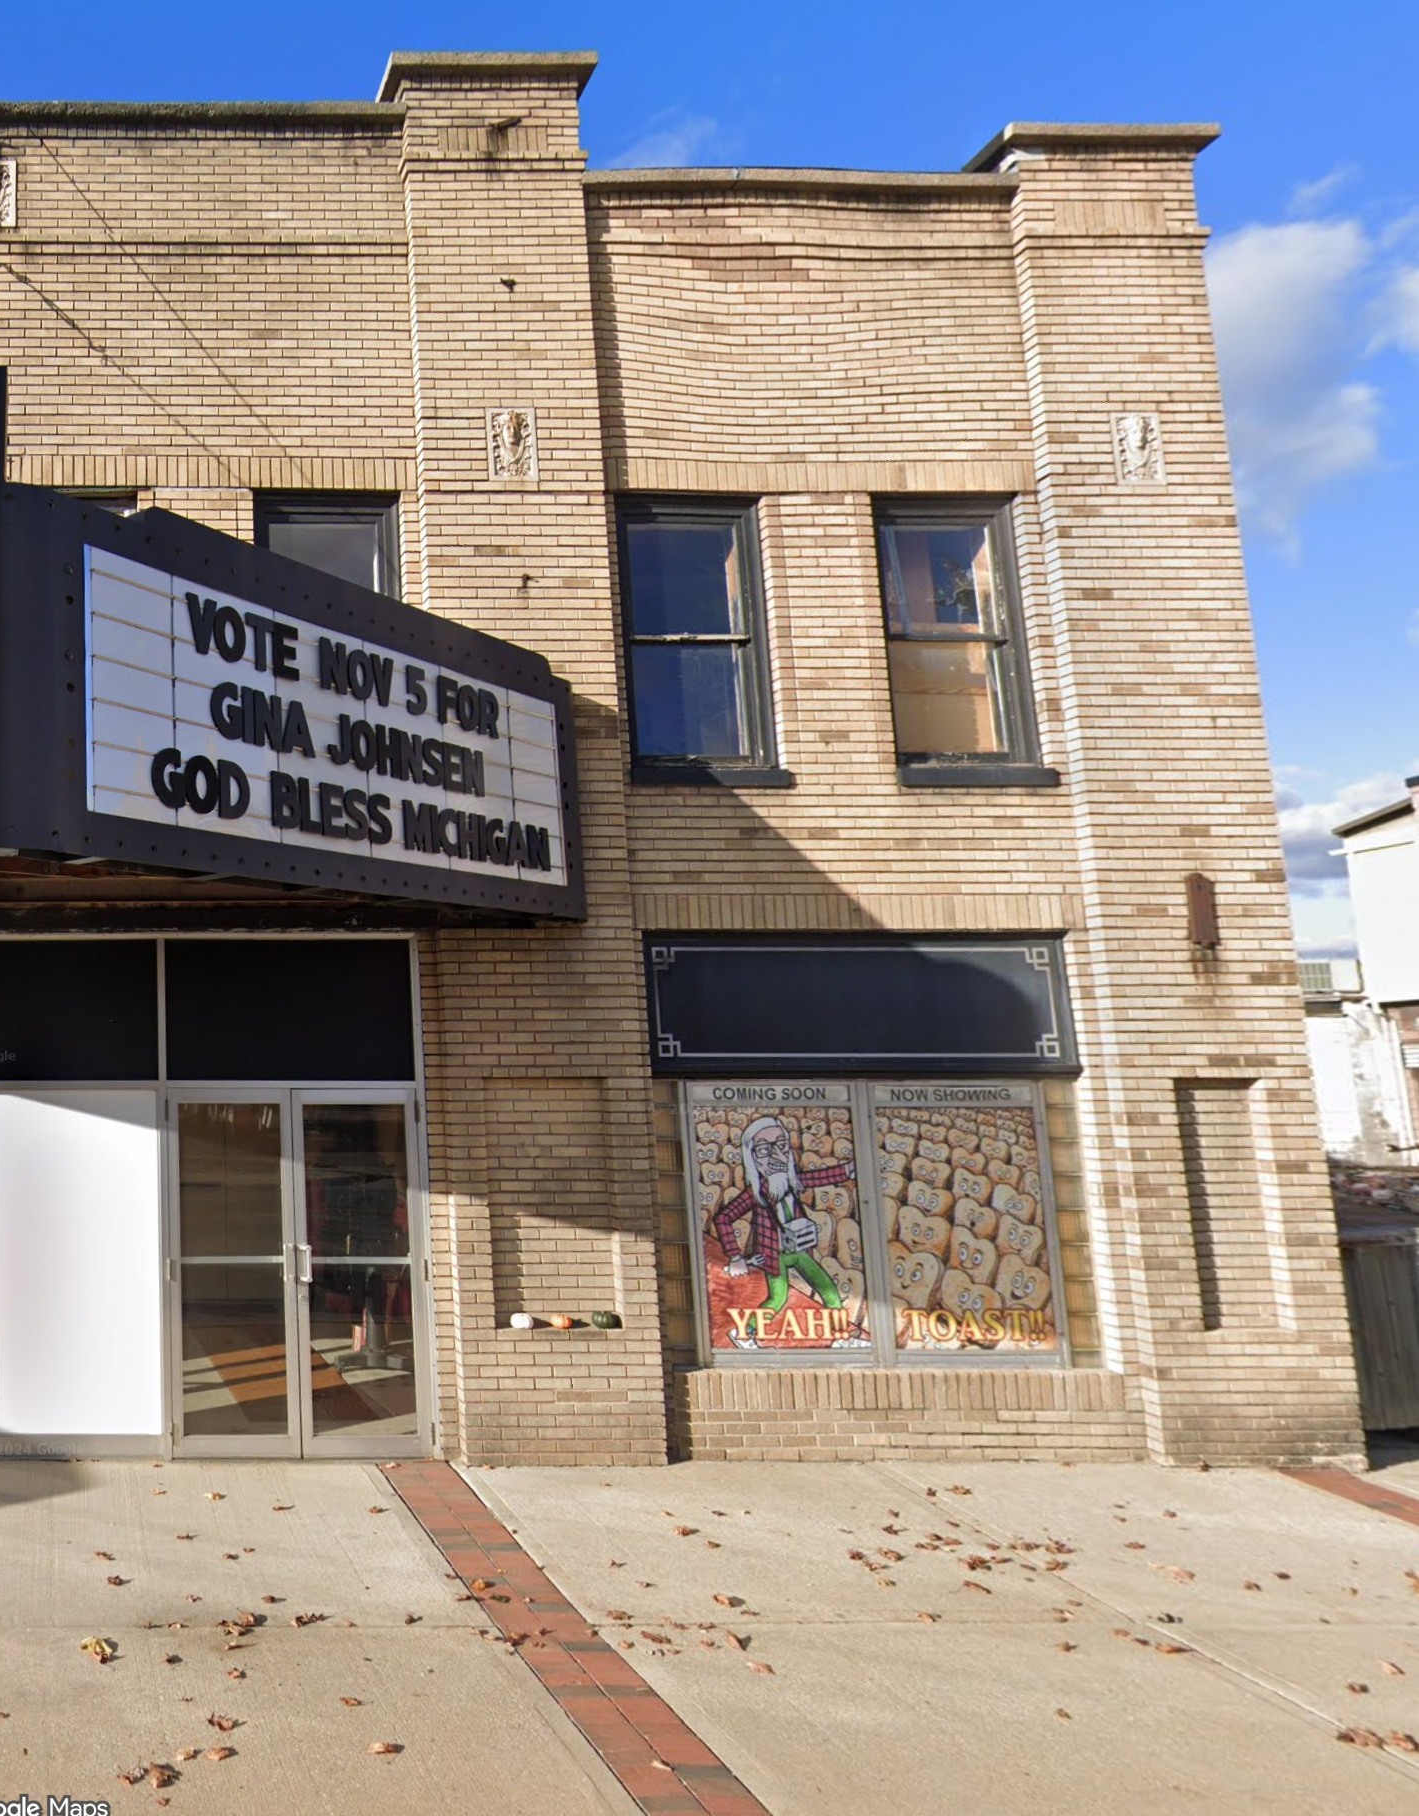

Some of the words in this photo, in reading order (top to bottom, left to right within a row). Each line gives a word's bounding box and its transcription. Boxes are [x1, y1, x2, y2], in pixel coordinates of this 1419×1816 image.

[185, 592, 300, 681] VOTE
[319, 636, 394, 707] NOV
[404, 664, 428, 715] 5
[437, 675, 500, 739] FOR
[210, 682, 316, 759] GINA
[328, 713, 486, 798] JOHNSEN
[151, 747, 250, 820] GOD
[270, 770, 392, 845] BLESS
[402, 799, 552, 872] MICHIGAN
[712, 1086, 777, 1101] COMING
[781, 1087, 827, 1101] SOON
[890, 1088, 929, 1102] NOW
[933, 1088, 1011, 1102] SHOWING
[727, 1306, 850, 1341] YEAH!!
[904, 1308, 1047, 1343] TOAST!!
